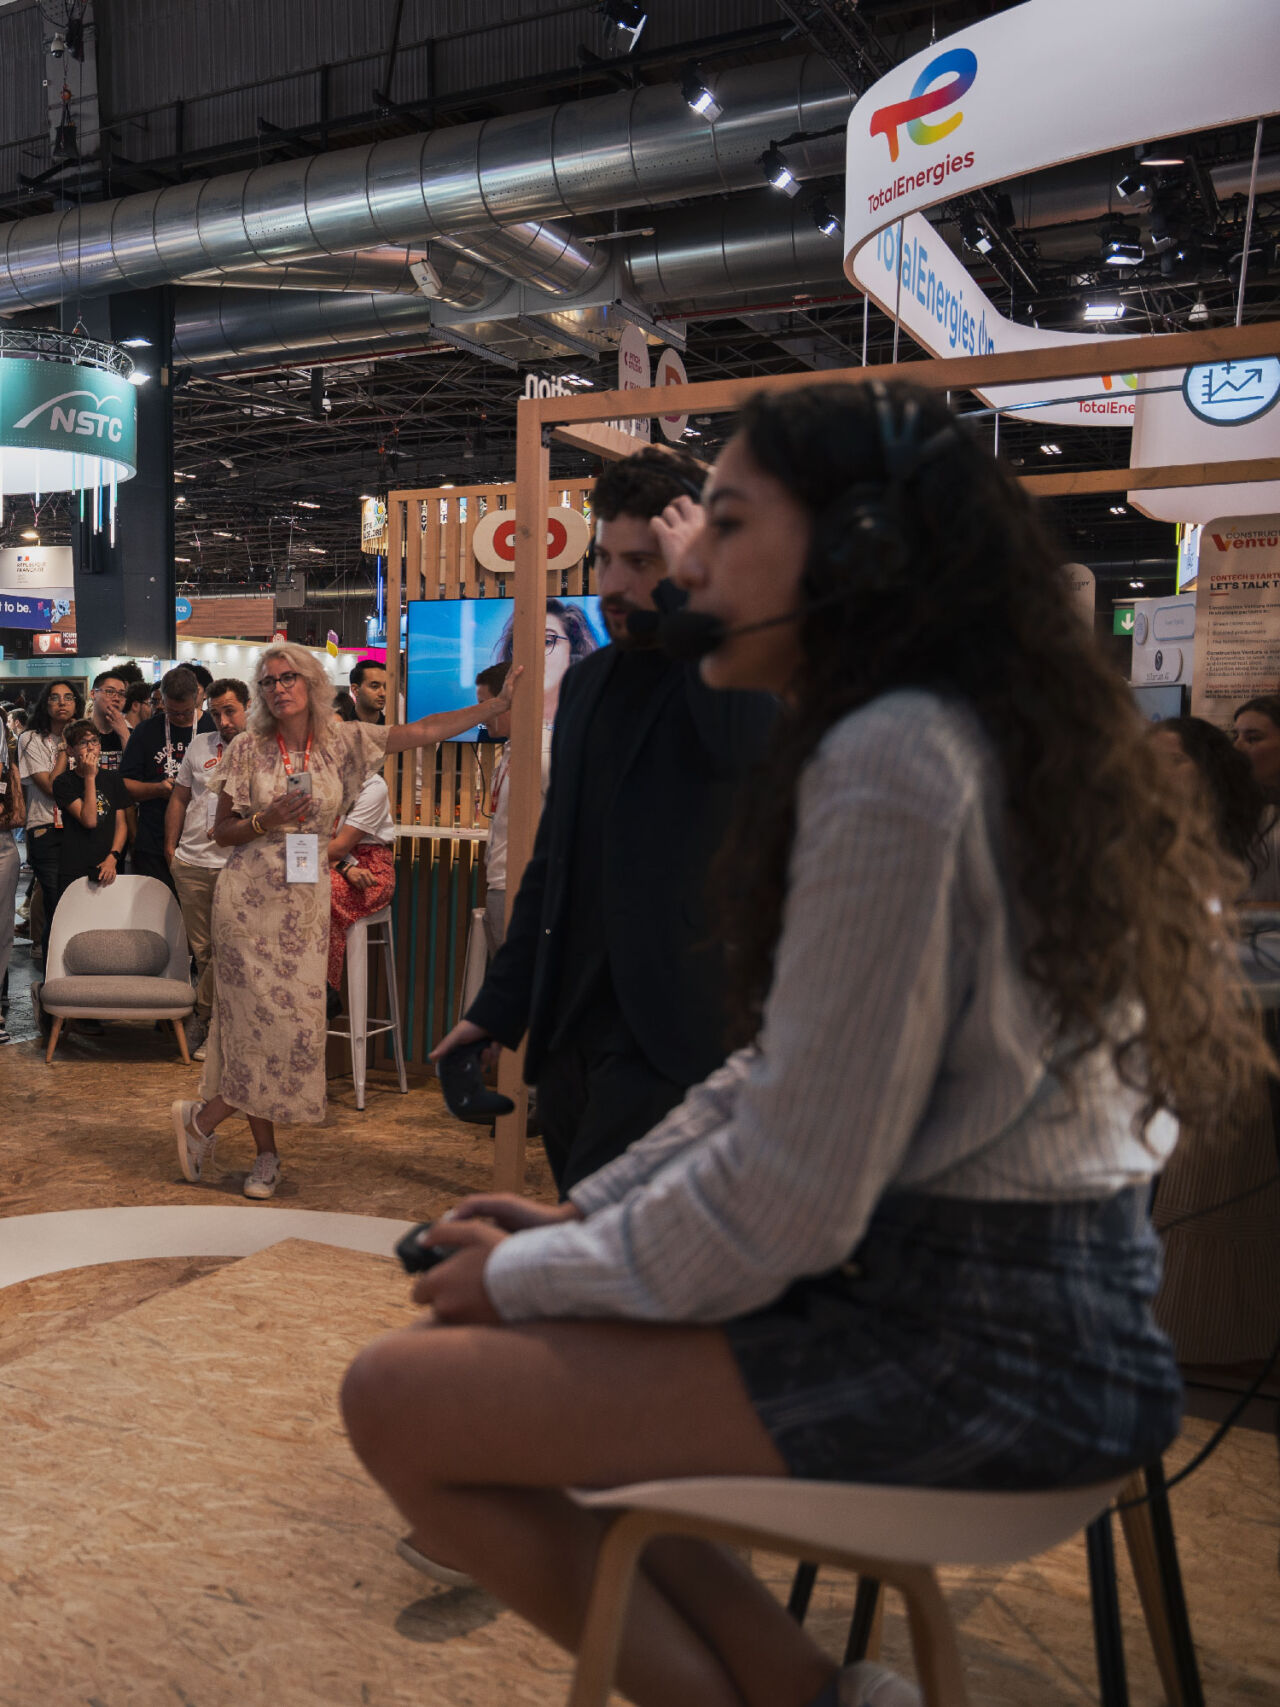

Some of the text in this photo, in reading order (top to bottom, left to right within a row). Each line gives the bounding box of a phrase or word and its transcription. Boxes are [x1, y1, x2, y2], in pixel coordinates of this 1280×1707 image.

[868, 151, 975, 214] TotalEnergies
[49, 405, 123, 442] NSTC
[1225, 530, 1280, 539] CONSTRUC
[1210, 582, 1239, 591] LET'S
[1242, 580, 1269, 589] TALK
[4, 600, 14, 612] to
